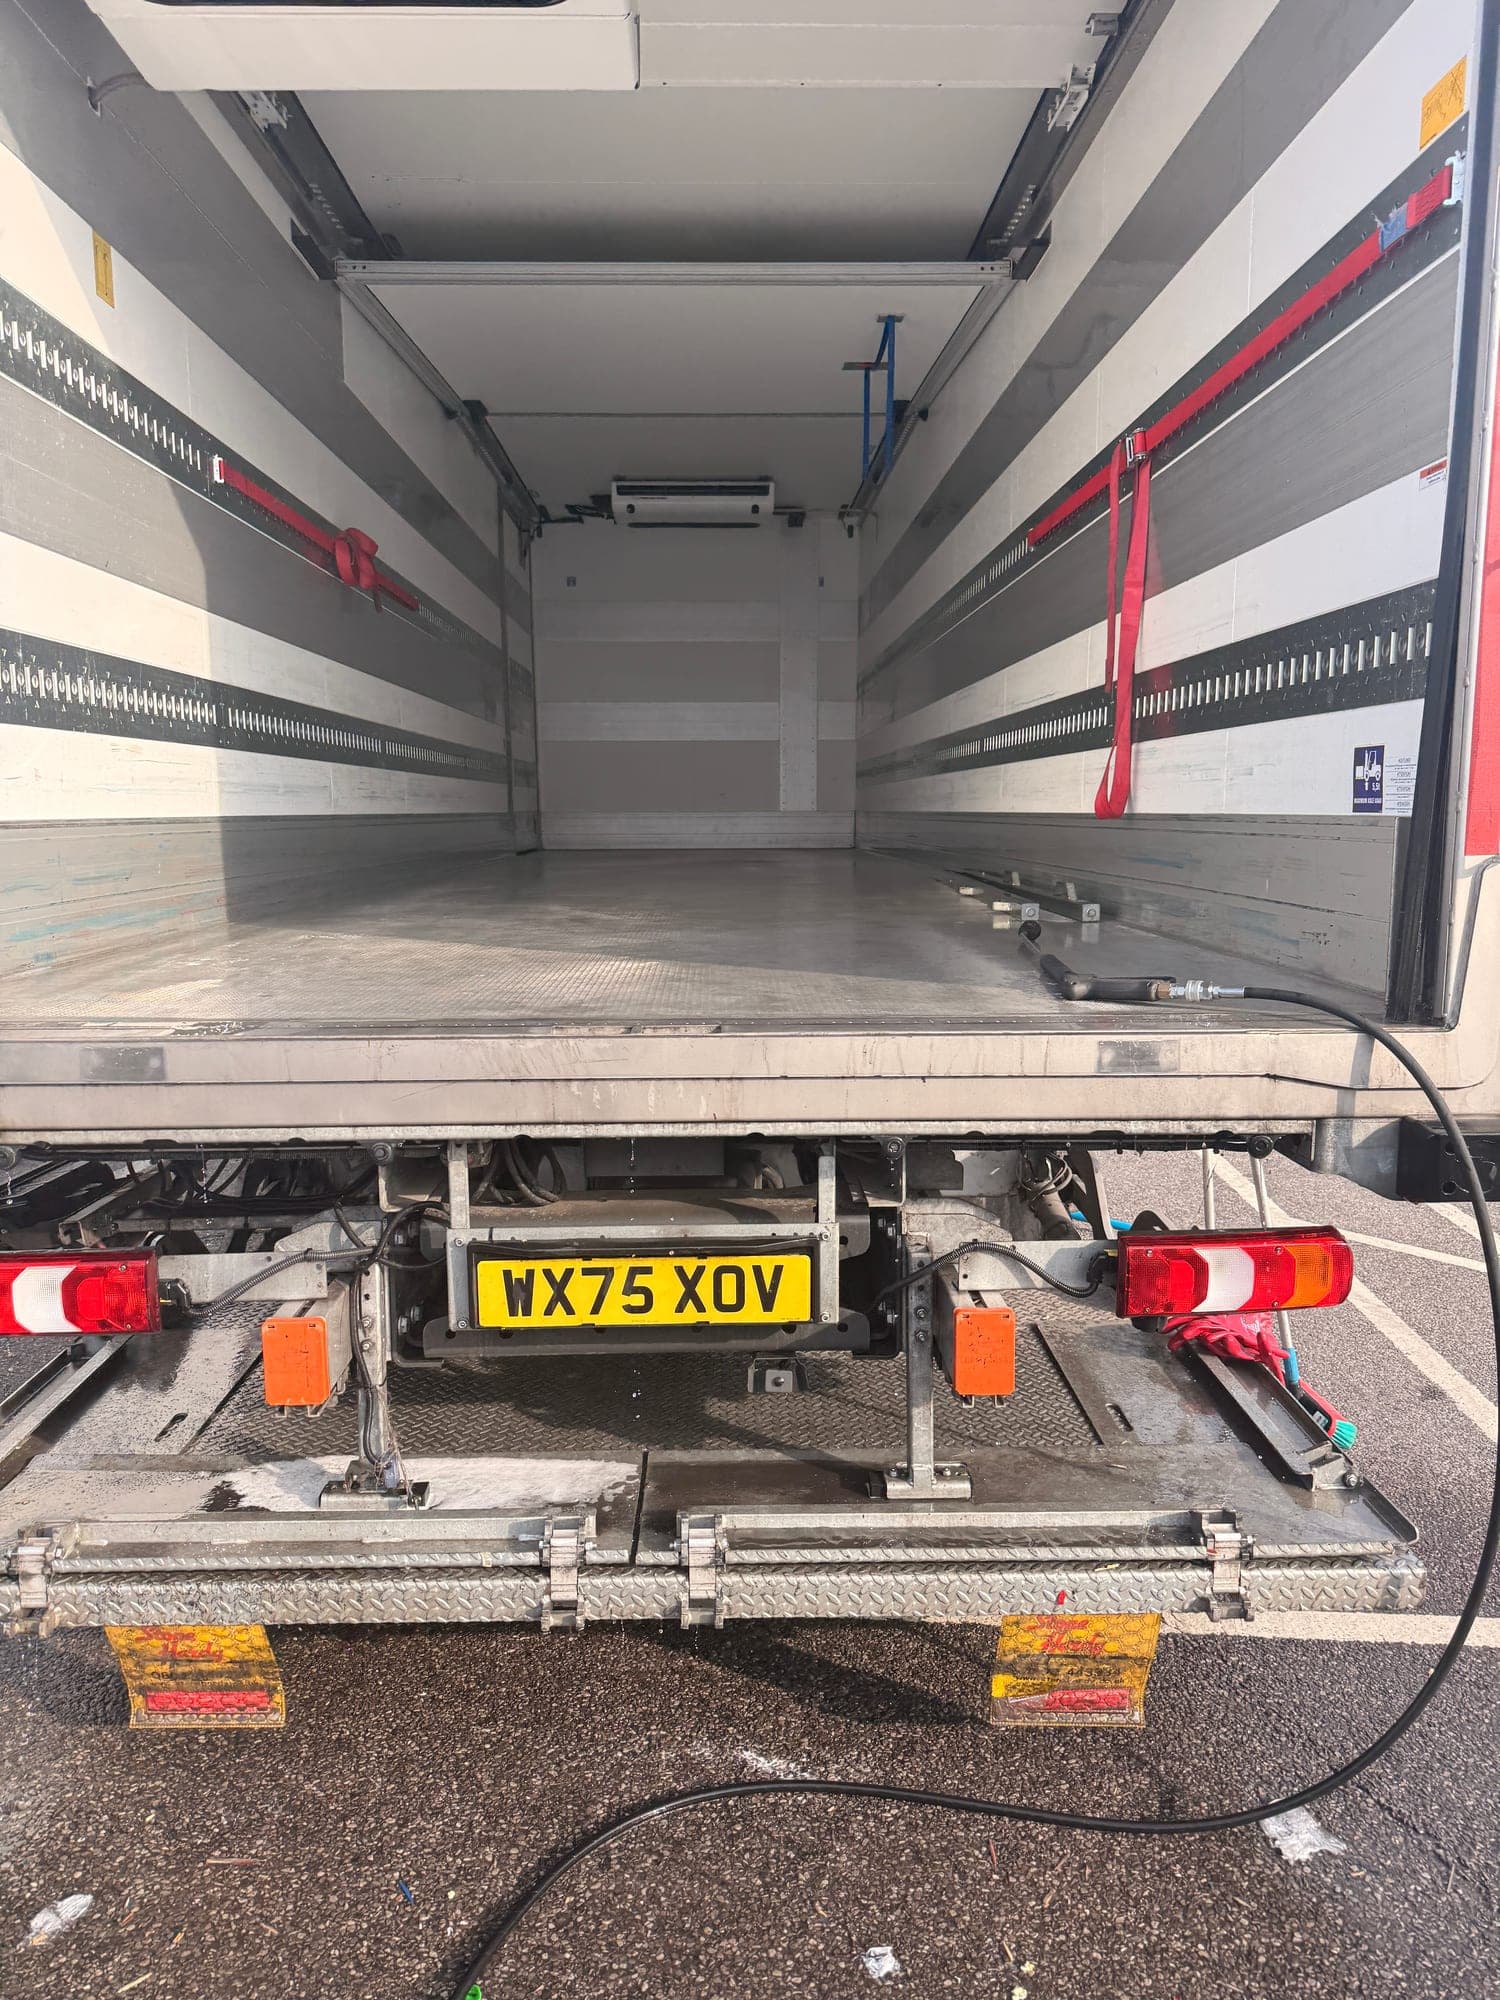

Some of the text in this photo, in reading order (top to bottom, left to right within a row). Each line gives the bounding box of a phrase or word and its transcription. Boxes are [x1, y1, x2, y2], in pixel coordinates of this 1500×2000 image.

[502, 1264, 784, 1317] WX75 XOV
[160, 1642, 224, 1662] Hardy
